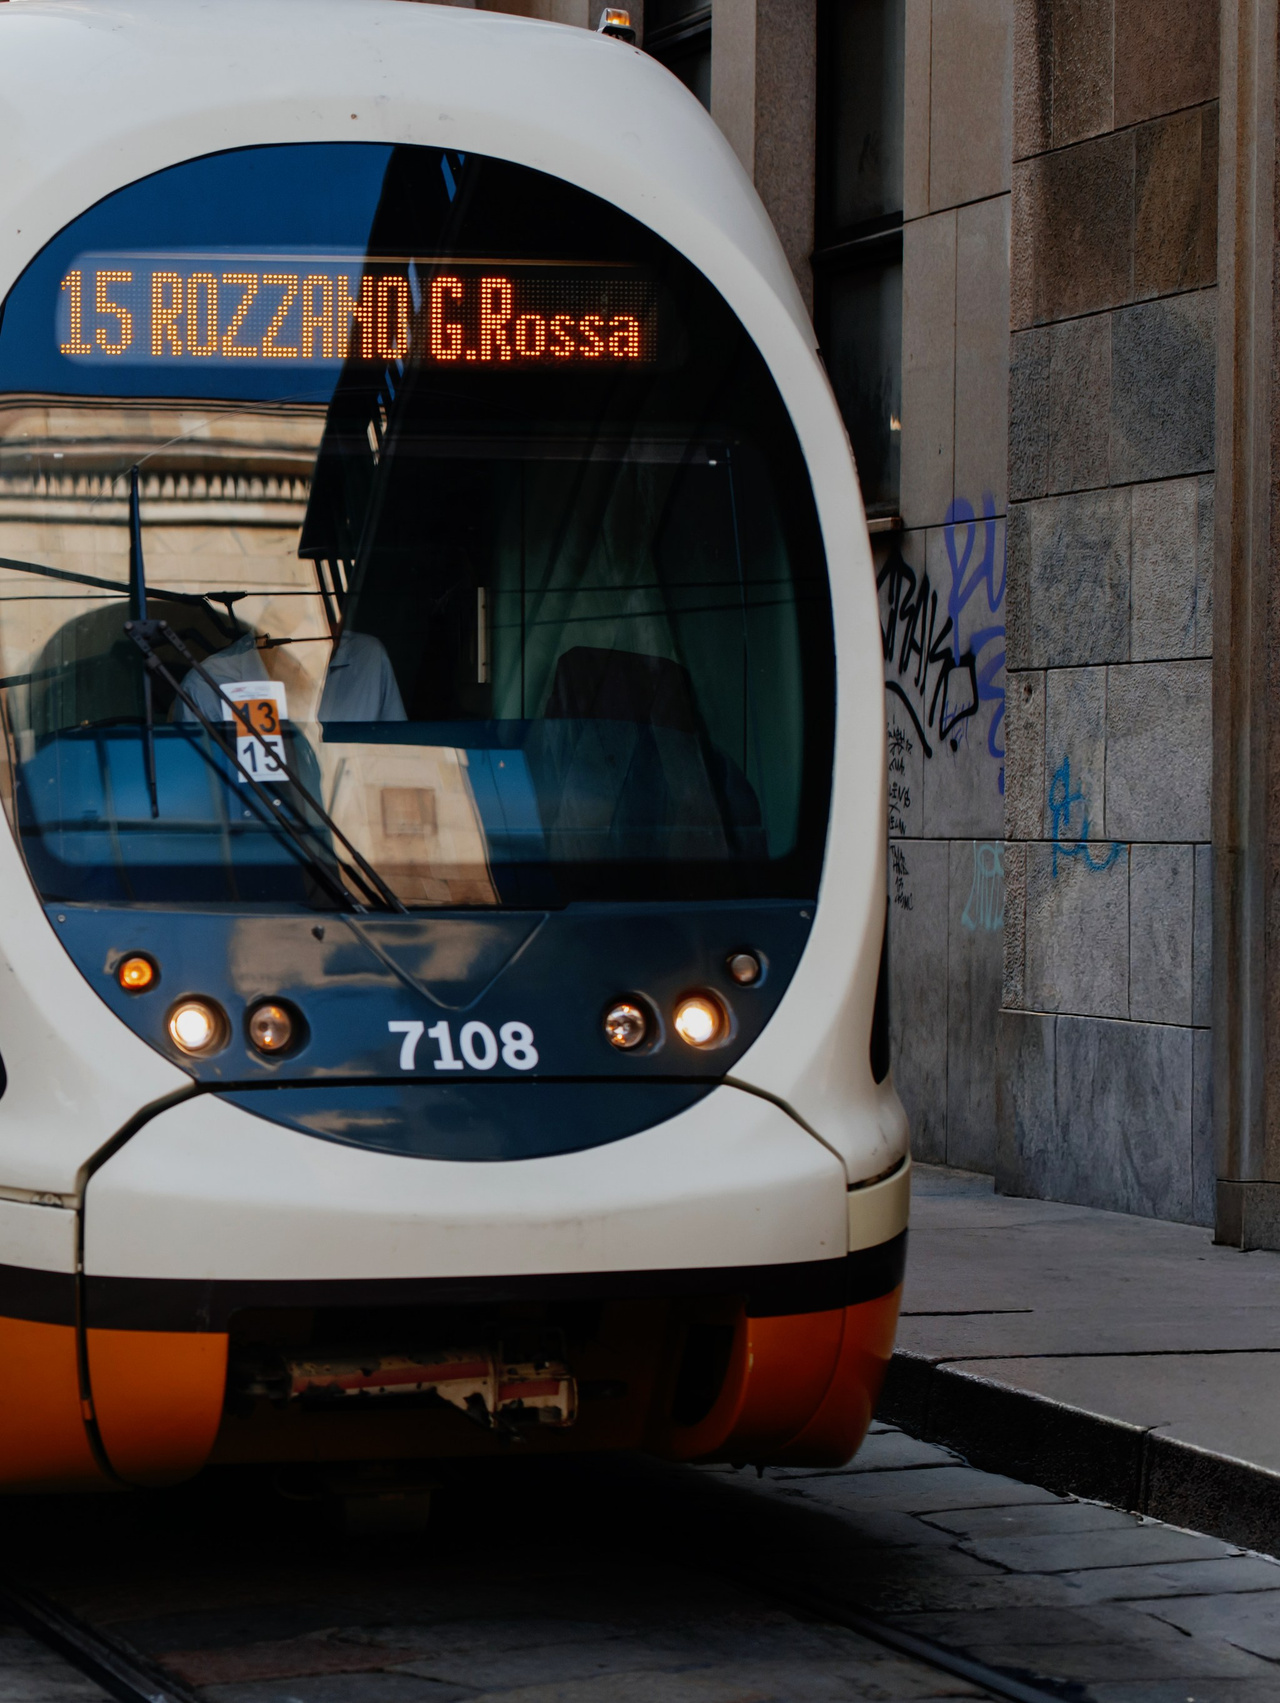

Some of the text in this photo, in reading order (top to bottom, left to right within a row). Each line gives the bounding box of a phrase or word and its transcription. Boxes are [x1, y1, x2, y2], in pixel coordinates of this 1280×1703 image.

[60, 270, 639, 360] 15 ROZZANO G.Rossa
[239, 702, 276, 733] 13
[242, 741, 281, 773] 15
[387, 1020, 539, 1071] 7108
